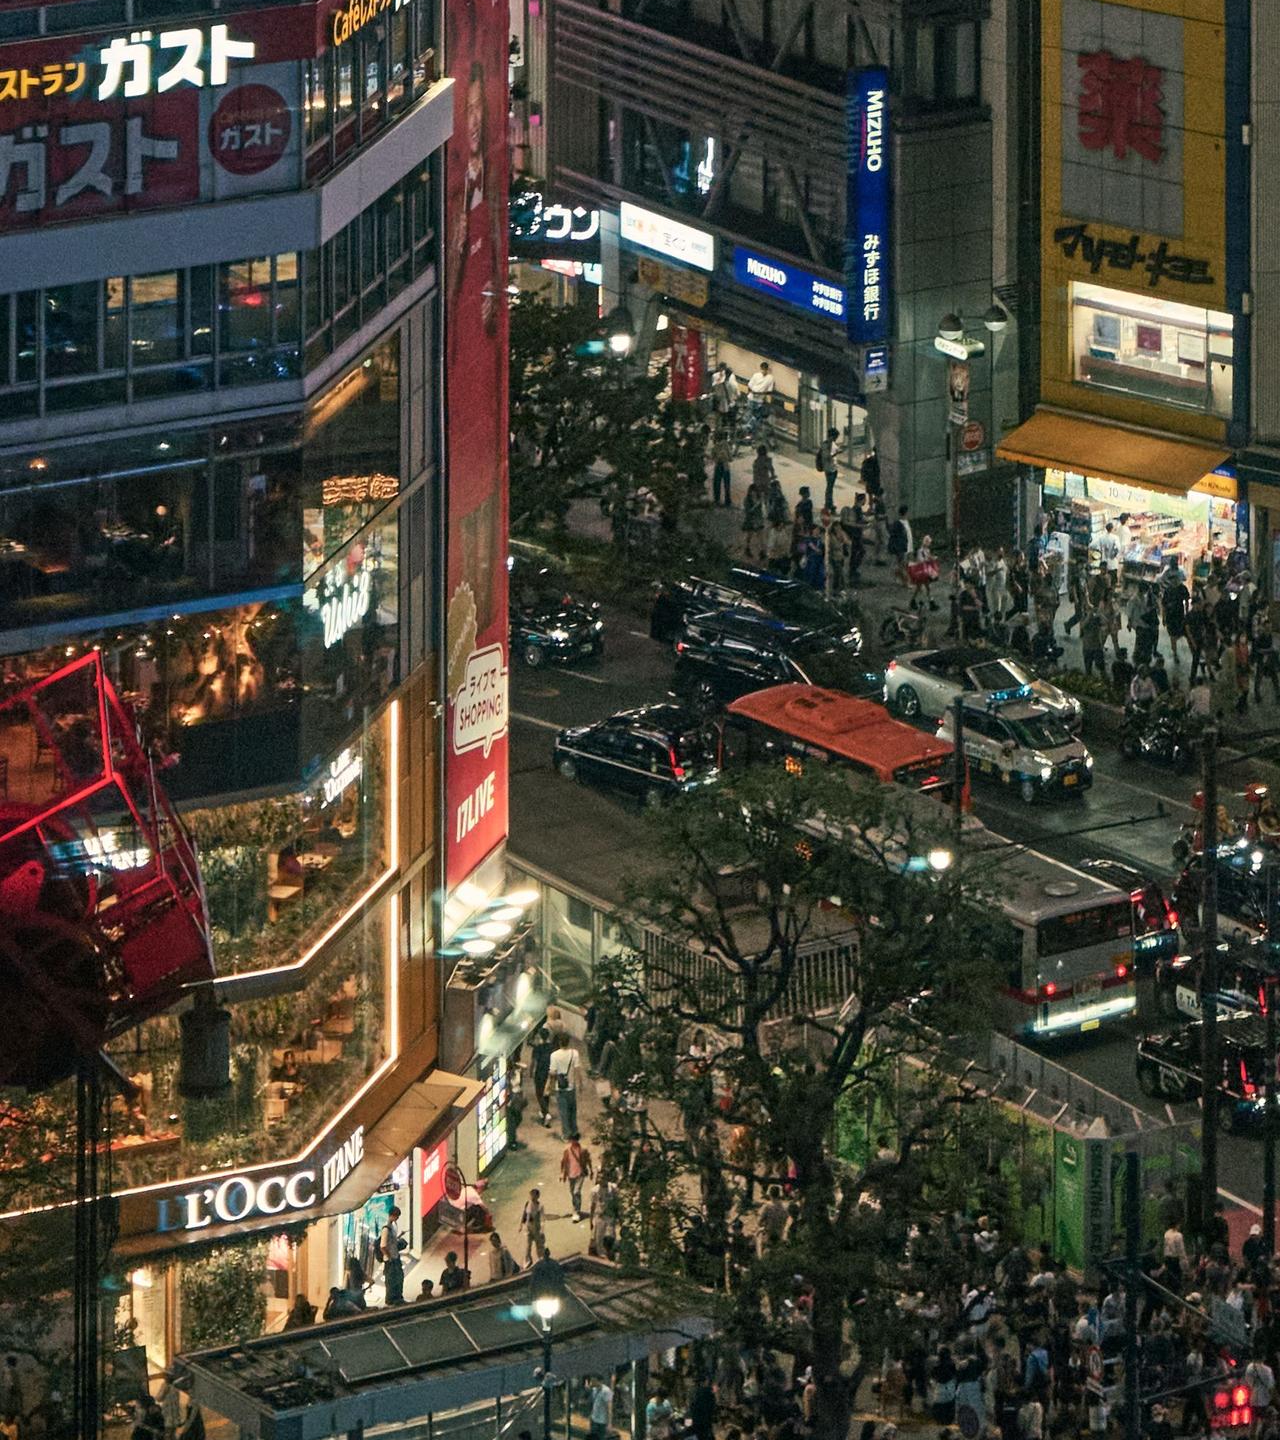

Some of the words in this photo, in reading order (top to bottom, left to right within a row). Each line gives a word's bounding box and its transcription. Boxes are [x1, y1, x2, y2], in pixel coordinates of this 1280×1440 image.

[98, 24, 255, 101] ガスト
[219, 123, 283, 151] ガスト
[866, 89, 883, 174] MIZUHO
[1076, 49, 1167, 166] 薬
[747, 257, 787, 287] MIZUHO
[862, 233, 882, 321] みずほ銀行
[456, 771, 496, 844] 17LIVE
